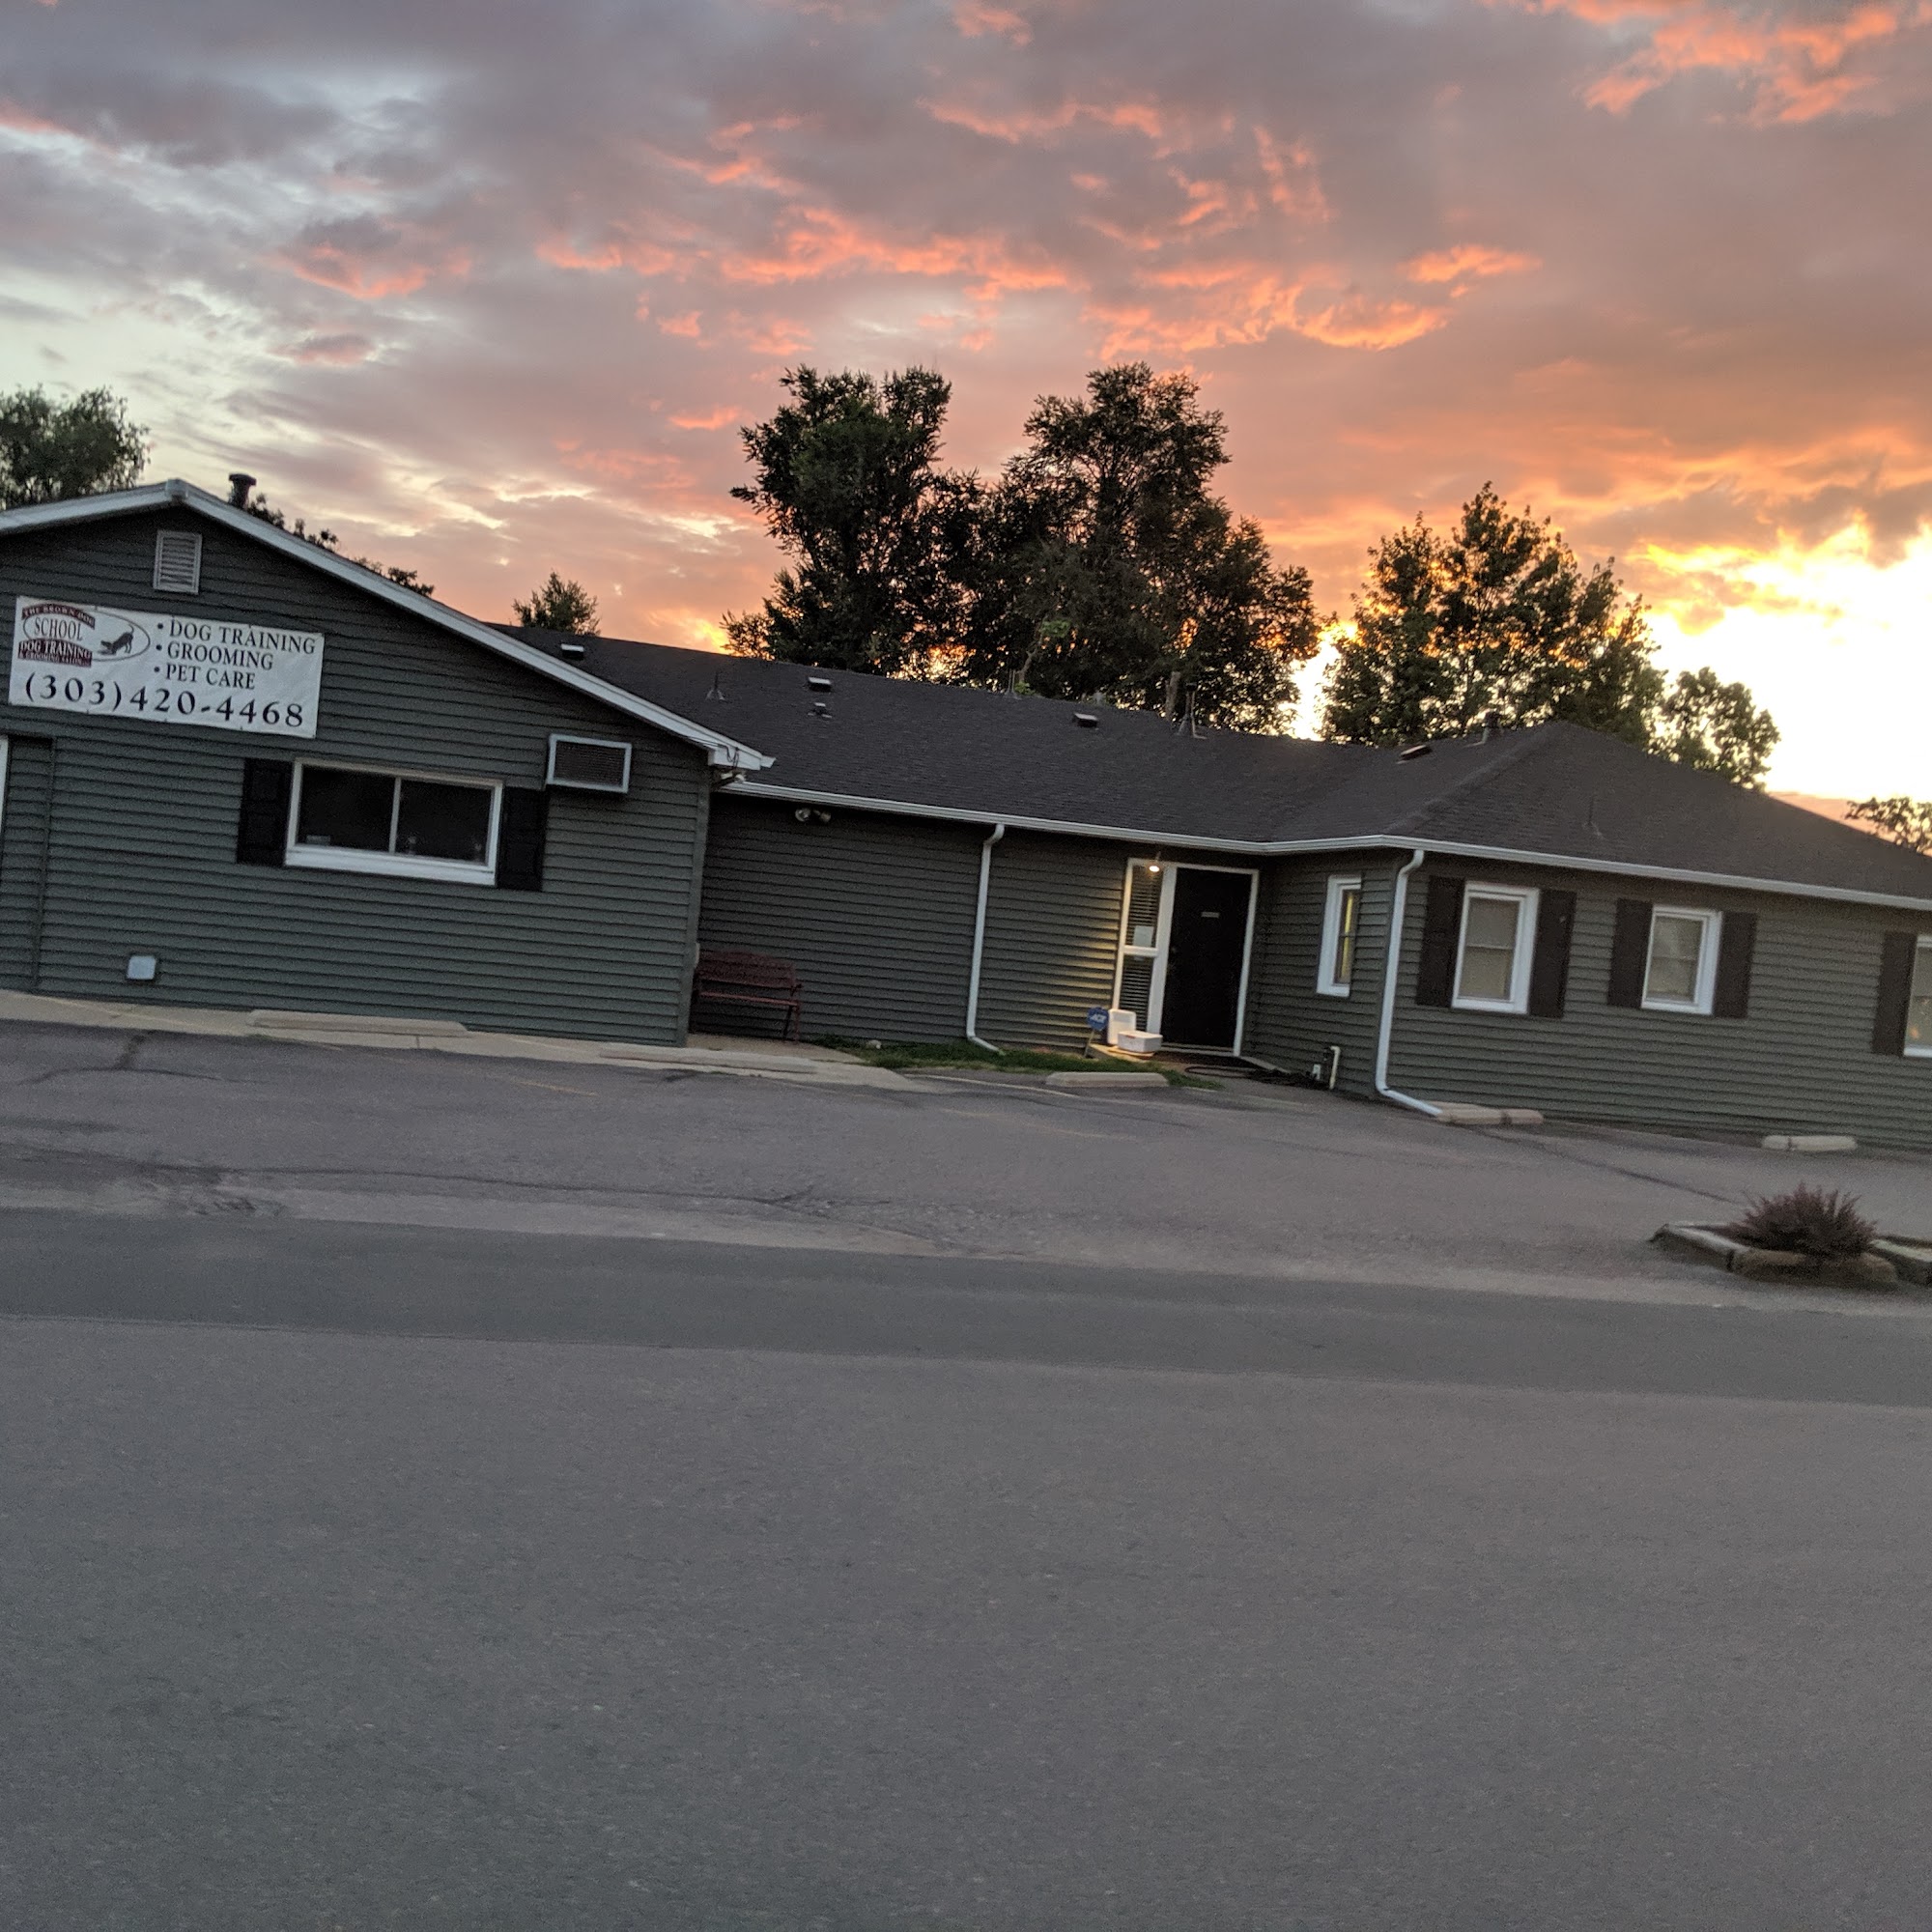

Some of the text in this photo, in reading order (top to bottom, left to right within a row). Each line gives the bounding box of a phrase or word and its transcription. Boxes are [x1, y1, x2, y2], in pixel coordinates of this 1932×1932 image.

[24, 607, 40, 617] THE
[43, 605, 75, 616] BROWN
[34, 616, 83, 641] SCHOOL
[168, 618, 316, 655] DOG TRAINING
[20, 639, 92, 659] DOG TRAINING
[167, 642, 274, 670] GROOMING
[165, 664, 256, 690] PET CARE
[25, 670, 304, 728] (303)420-4468
